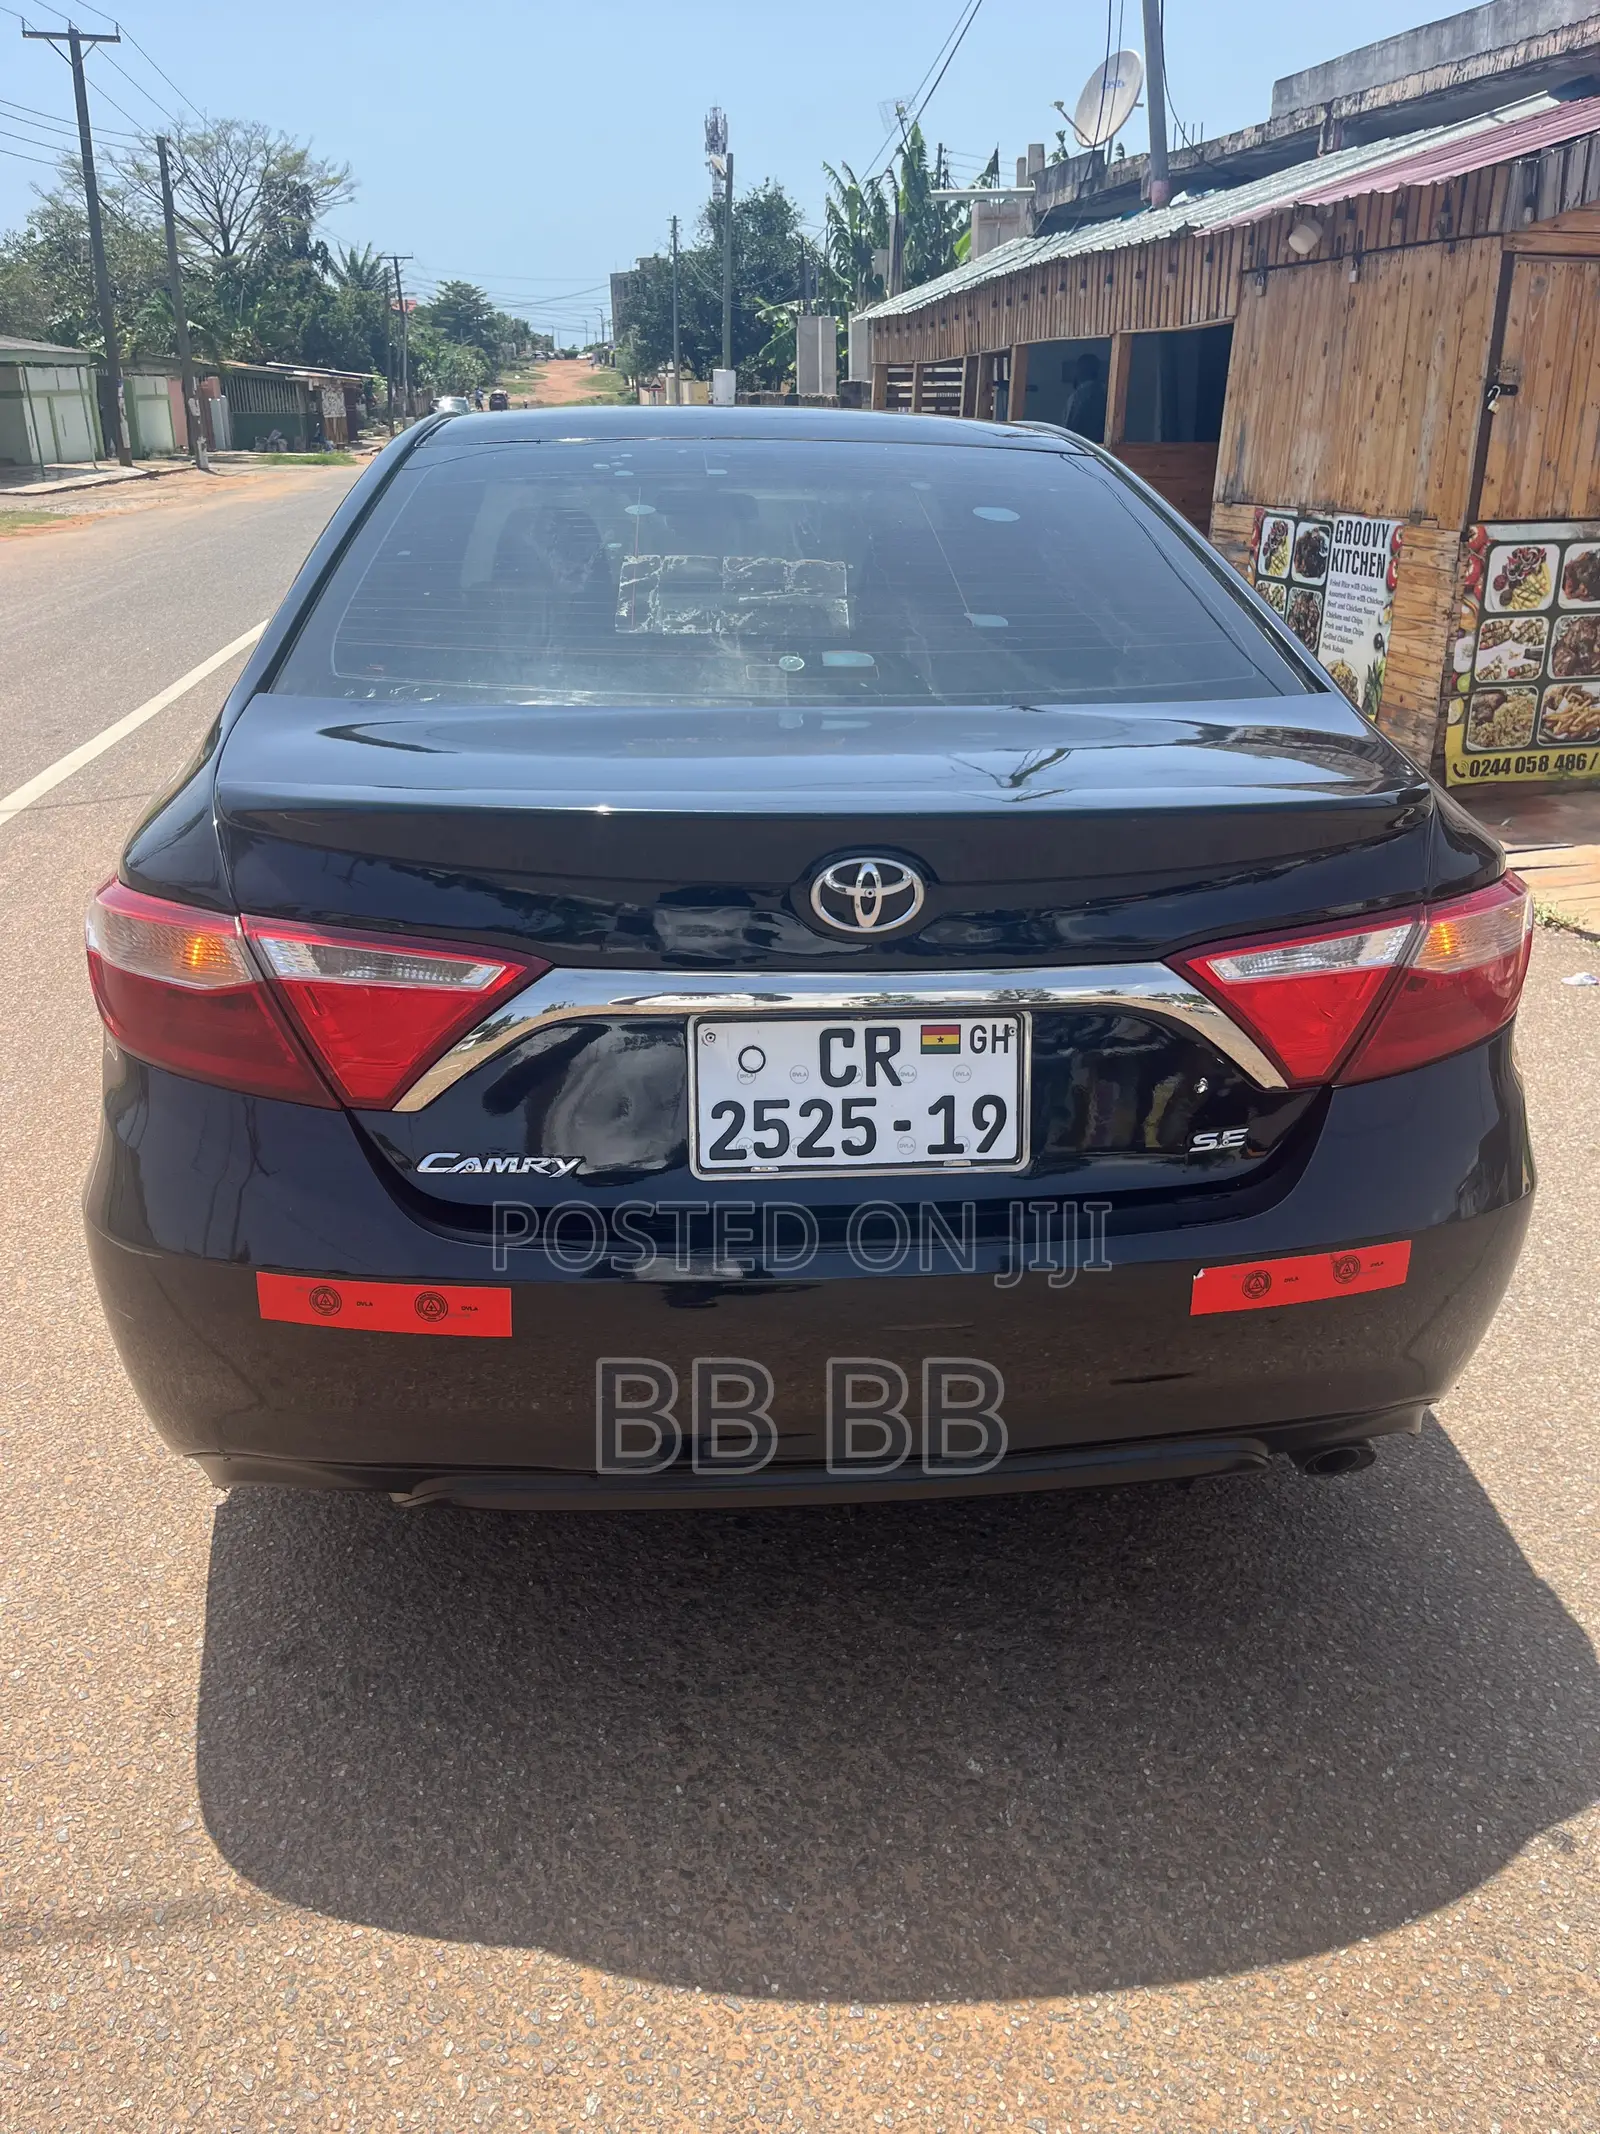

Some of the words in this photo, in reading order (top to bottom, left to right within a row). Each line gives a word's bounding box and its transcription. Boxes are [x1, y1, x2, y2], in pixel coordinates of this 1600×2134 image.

[1335, 520, 1390, 549] GROOVY
[1331, 548, 1386, 579] KITCHEN
[1340, 580, 1350, 588] Rice
[1351, 582, 1360, 590] with
[1360, 583, 1378, 593] Chicken
[1337, 602, 1345, 610] and
[1346, 603, 1363, 614] Chicken
[1357, 594, 1366, 602] with
[1366, 596, 1384, 606] Chicken
[1326, 611, 1342, 620] Chicken
[1343, 615, 1351, 623] and
[1351, 616, 1363, 626] Chips
[1337, 635, 1353, 645] Chicken
[1352, 627, 1364, 638] Chips
[1469, 757, 1511, 778] 0244
[1514, 755, 1549, 774] 058
[1554, 753, 1587, 771] 486
[969, 1024, 1010, 1054] GH
[820, 1027, 902, 1088] CR
[709, 1094, 1007, 1161] 2525-19
[1188, 1127, 1250, 1153] SE
[416, 1152, 582, 1178] CAMRY
